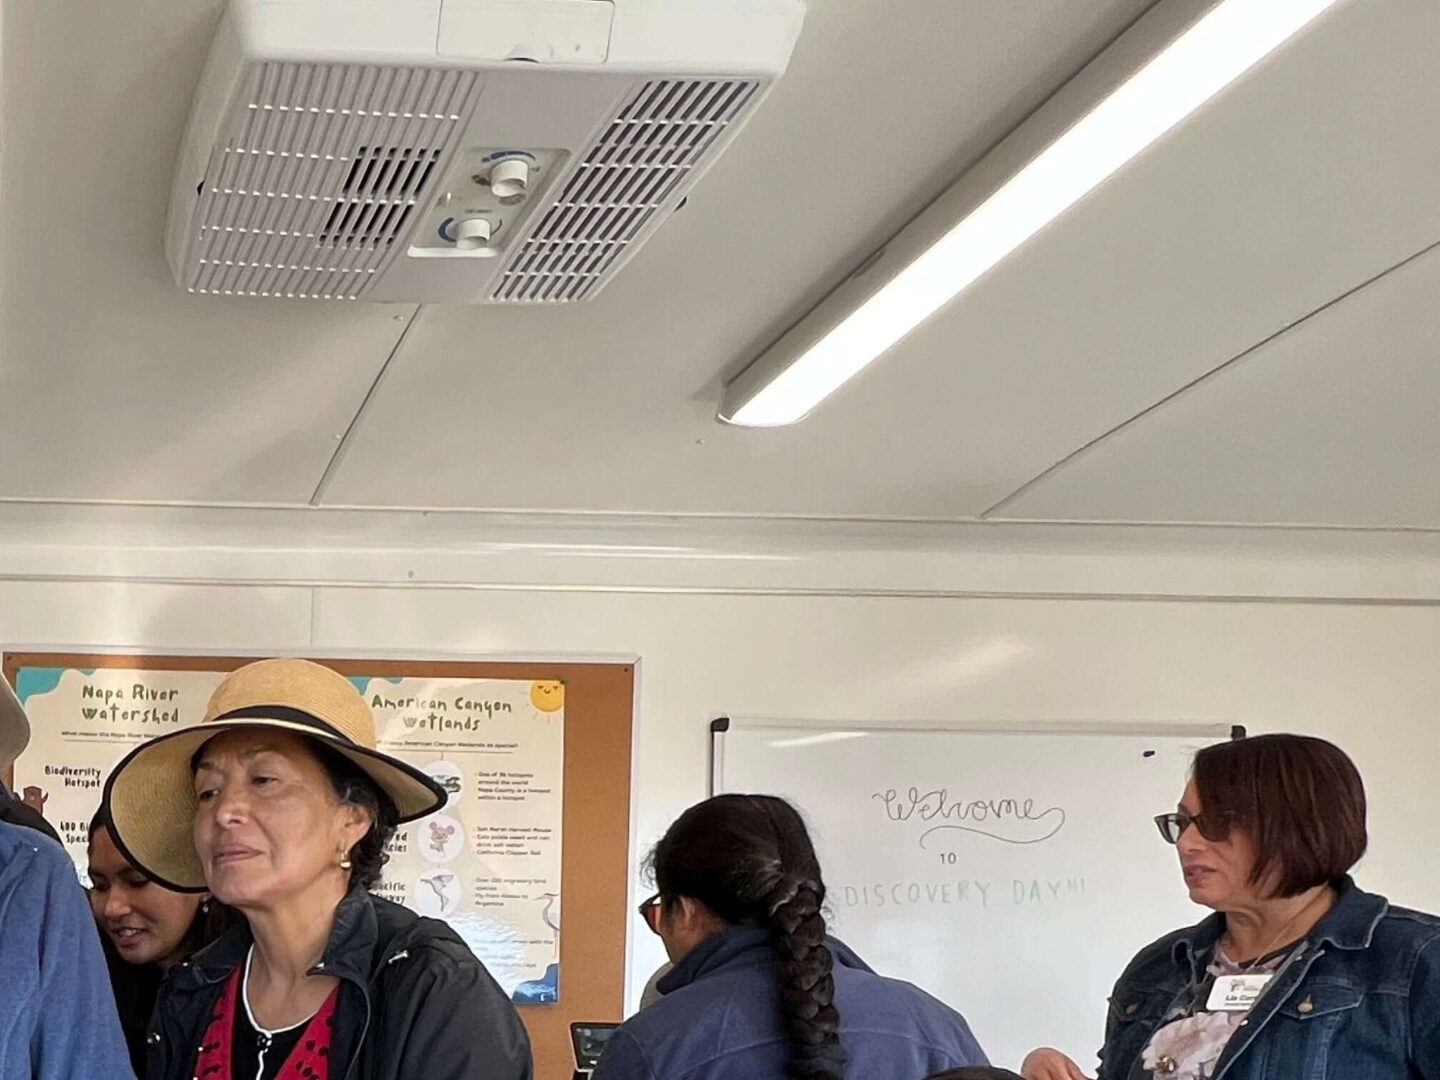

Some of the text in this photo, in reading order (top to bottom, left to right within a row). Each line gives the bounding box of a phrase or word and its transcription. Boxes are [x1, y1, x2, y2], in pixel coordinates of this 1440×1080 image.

[82, 683, 179, 706] Napa River
[371, 694, 512, 719] American Canyon
[45, 765, 101, 778] Biodiversity
[64, 777, 101, 788] Hotspot
[871, 787, 1065, 842] Welcome
[843, 877, 992, 909] DISCOVERY
